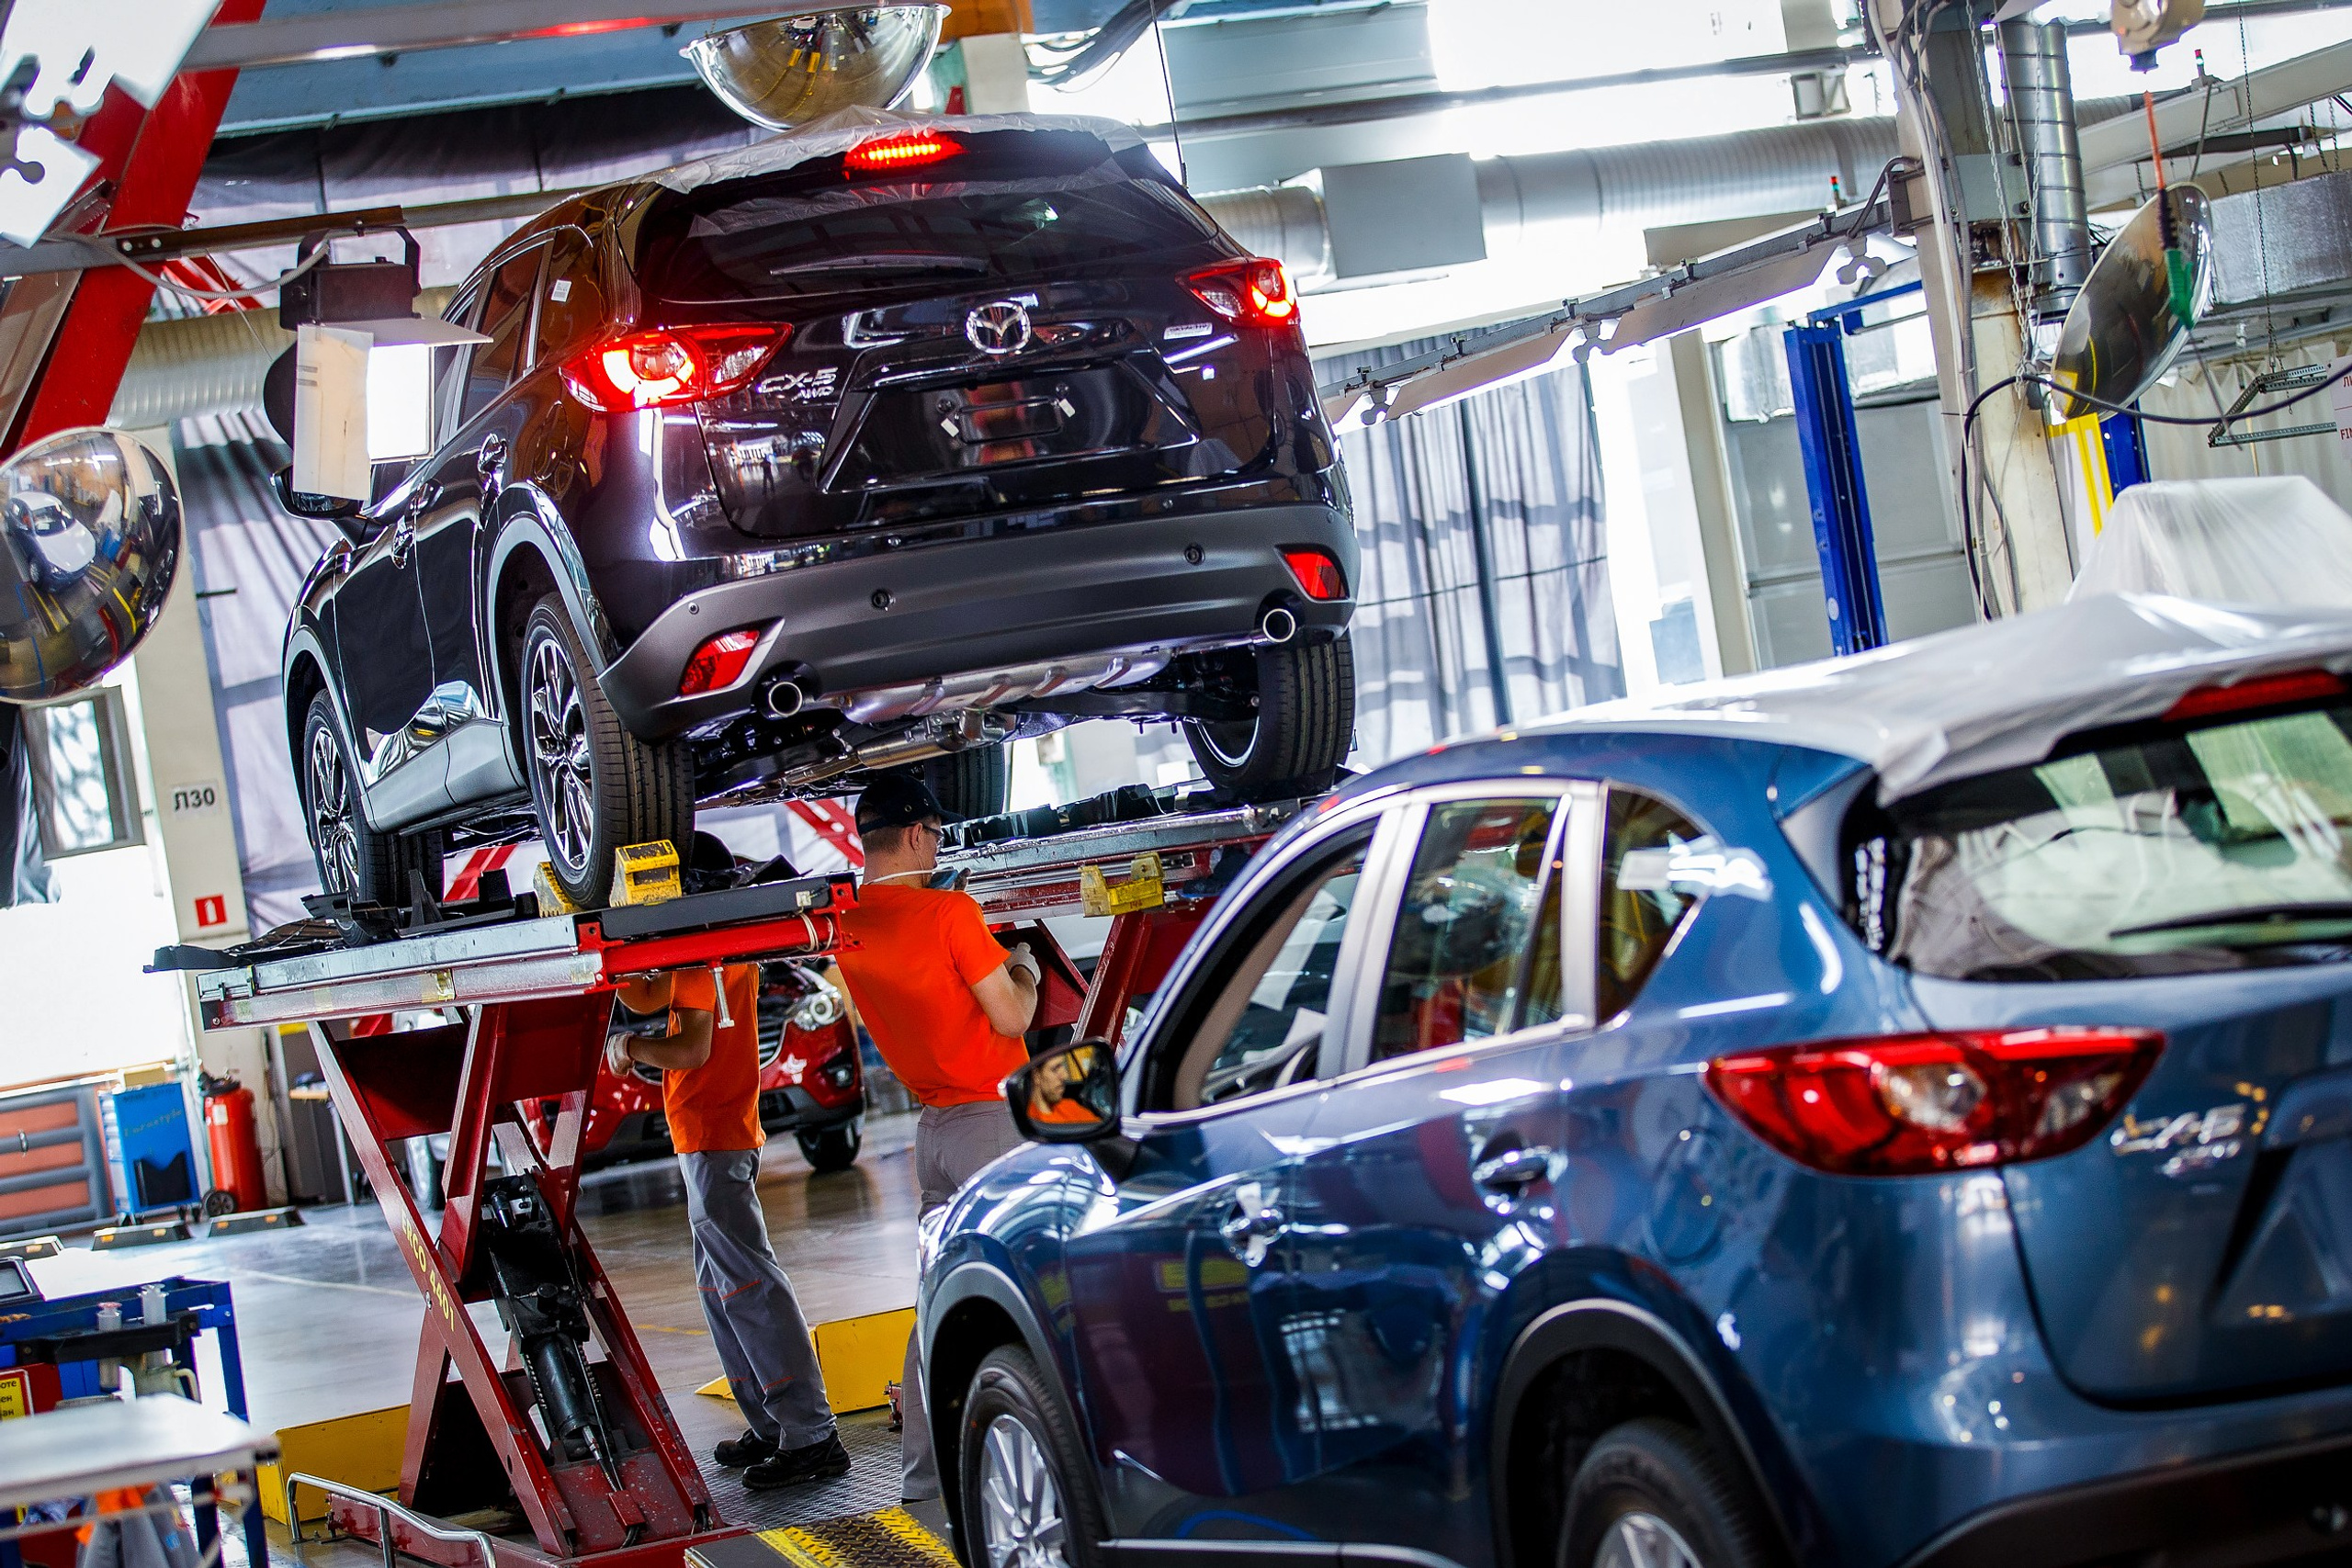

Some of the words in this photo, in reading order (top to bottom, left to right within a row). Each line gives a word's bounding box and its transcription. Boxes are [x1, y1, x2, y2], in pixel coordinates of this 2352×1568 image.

[758, 367, 838, 393] CX-5
[791, 386, 835, 402] AWD
[429, 1269, 454, 1332] 4401
